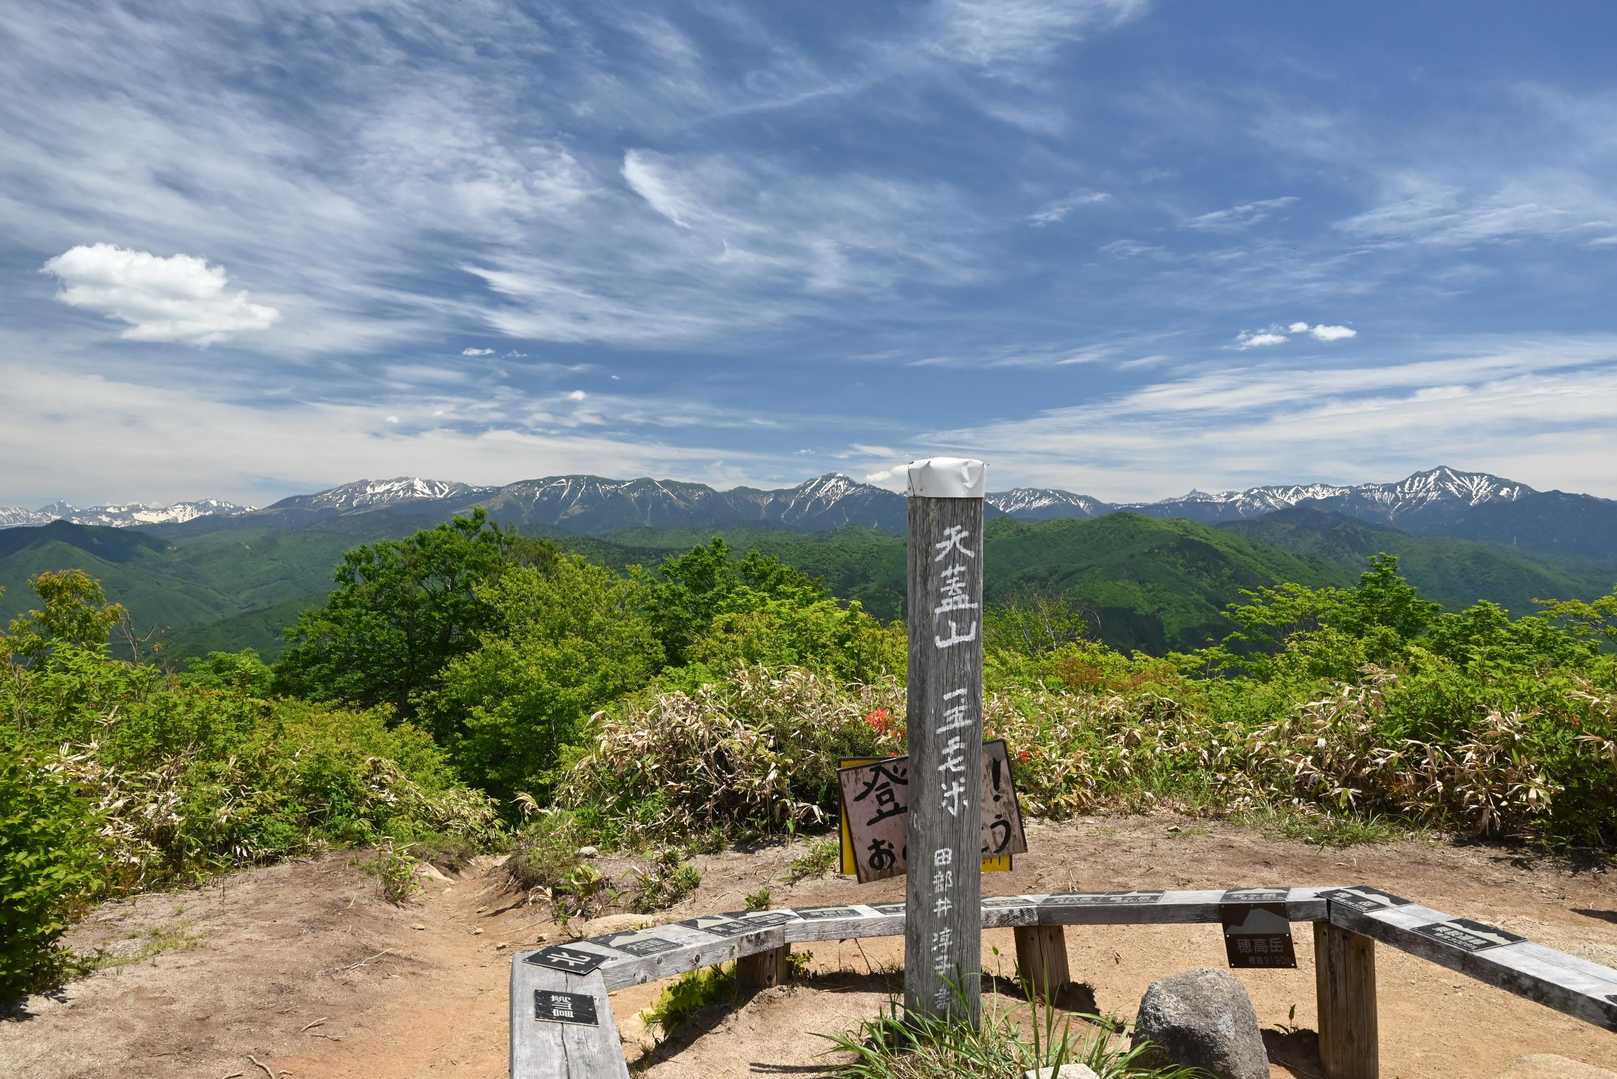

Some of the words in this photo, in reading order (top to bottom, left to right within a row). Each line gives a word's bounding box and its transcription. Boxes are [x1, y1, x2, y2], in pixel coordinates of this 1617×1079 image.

[935, 525, 978, 649] 天蓋山
[546, 951, 592, 967] 北
